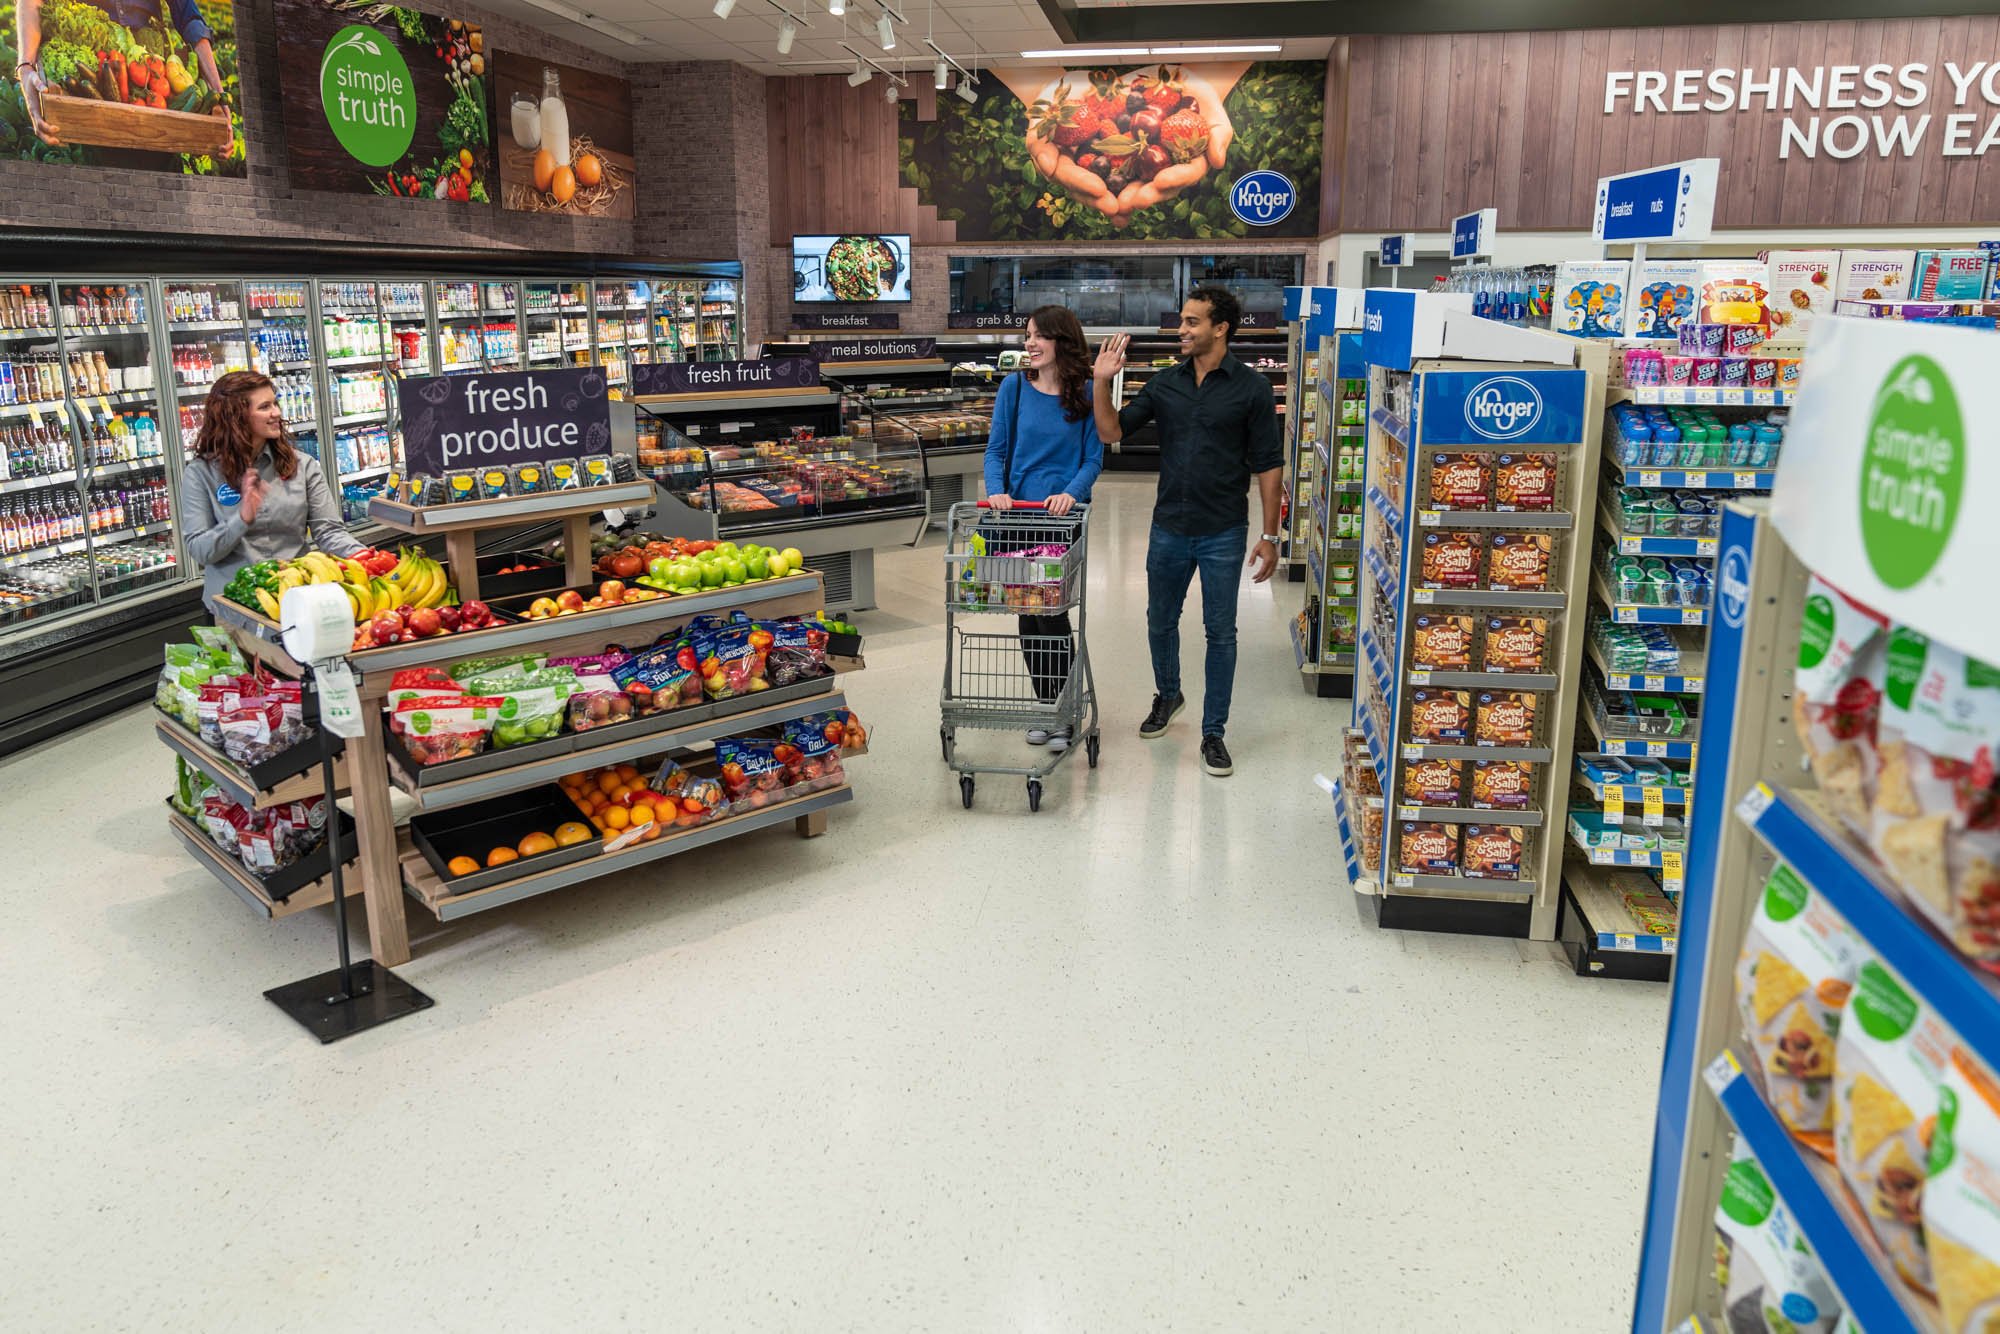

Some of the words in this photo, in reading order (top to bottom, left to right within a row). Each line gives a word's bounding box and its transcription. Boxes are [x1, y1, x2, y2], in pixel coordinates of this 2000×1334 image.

[336, 64, 403, 96] simple
[1603, 62, 1928, 114] FRESHNESS
[338, 92, 405, 128] truth
[1778, 113, 1932, 160] NOW
[1238, 180, 1289, 218] Kroger
[1610, 201, 1634, 218] breakfast
[1650, 198, 1664, 213] nuts
[1679, 203, 1687, 228] 5
[1778, 263, 1829, 272] STRENGTH
[1851, 263, 1903, 272] STRENGTH
[1950, 257, 1983, 271] FREE
[821, 315, 869, 326] breakfast
[976, 314, 1001, 327] grab
[1003, 314, 1012, 325] &
[1366, 308, 1382, 333] fresh
[1705, 328, 1717, 339] ICE
[1733, 329, 1746, 340] ICE
[831, 343, 861, 357] meal
[864, 341, 917, 355] solutions
[688, 365, 731, 385] fresh
[735, 363, 772, 382] fruit
[1673, 364, 1685, 373] ICE
[1697, 362, 1711, 373] ICE
[1725, 362, 1739, 373] ICE
[1753, 362, 1768, 372] ICE
[1783, 364, 1796, 373] ICE
[465, 377, 548, 414] fresh
[1474, 388, 1535, 430] Kroger
[440, 418, 579, 466] produce
[1873, 419, 1952, 474] simple
[1450, 466, 1481, 478] Sweet
[1515, 466, 1546, 478] Sweet
[1444, 474, 1453, 485] &
[1453, 477, 1481, 491] Salty
[1508, 475, 1518, 486] &
[1518, 477, 1546, 492] Salty
[1866, 464, 1946, 533] truth
[1440, 546, 1472, 557] Sweet
[1508, 547, 1539, 559] Sweet
[1435, 555, 1445, 564] &
[1445, 556, 1472, 570] Salty
[1503, 555, 1512, 566] &
[1512, 557, 1539, 572] Salty
[1431, 628, 1462, 640] Sweet
[1504, 631, 1534, 642] Sweet
[1426, 636, 1435, 647] &
[1436, 639, 1462, 653] Salty
[1499, 638, 1508, 649] &
[1507, 641, 1534, 655] Salty
[1429, 702, 1459, 714] Sweet
[1495, 705, 1524, 717] Sweet
[1424, 711, 1433, 721] &
[1432, 712, 1459, 727] Salty
[1489, 712, 1498, 723] &
[1498, 715, 1524, 729] Salty
[1422, 766, 1451, 777] Sweet
[1491, 768, 1520, 779] Sweet
[1416, 773, 1425, 783] &
[1425, 775, 1451, 789] Salty
[1485, 776, 1494, 786] &
[1494, 778, 1520, 792] Salty
[1604, 793, 1621, 801] FREE
[1644, 795, 1661, 803] FREE
[1418, 834, 1447, 845] Sweet
[1482, 837, 1512, 848] Sweet
[1413, 841, 1421, 851] &
[1421, 843, 1447, 858] Salty
[1477, 845, 1485, 855] &
[1486, 847, 1512, 861] Salty
[1663, 860, 1680, 868] FREE
